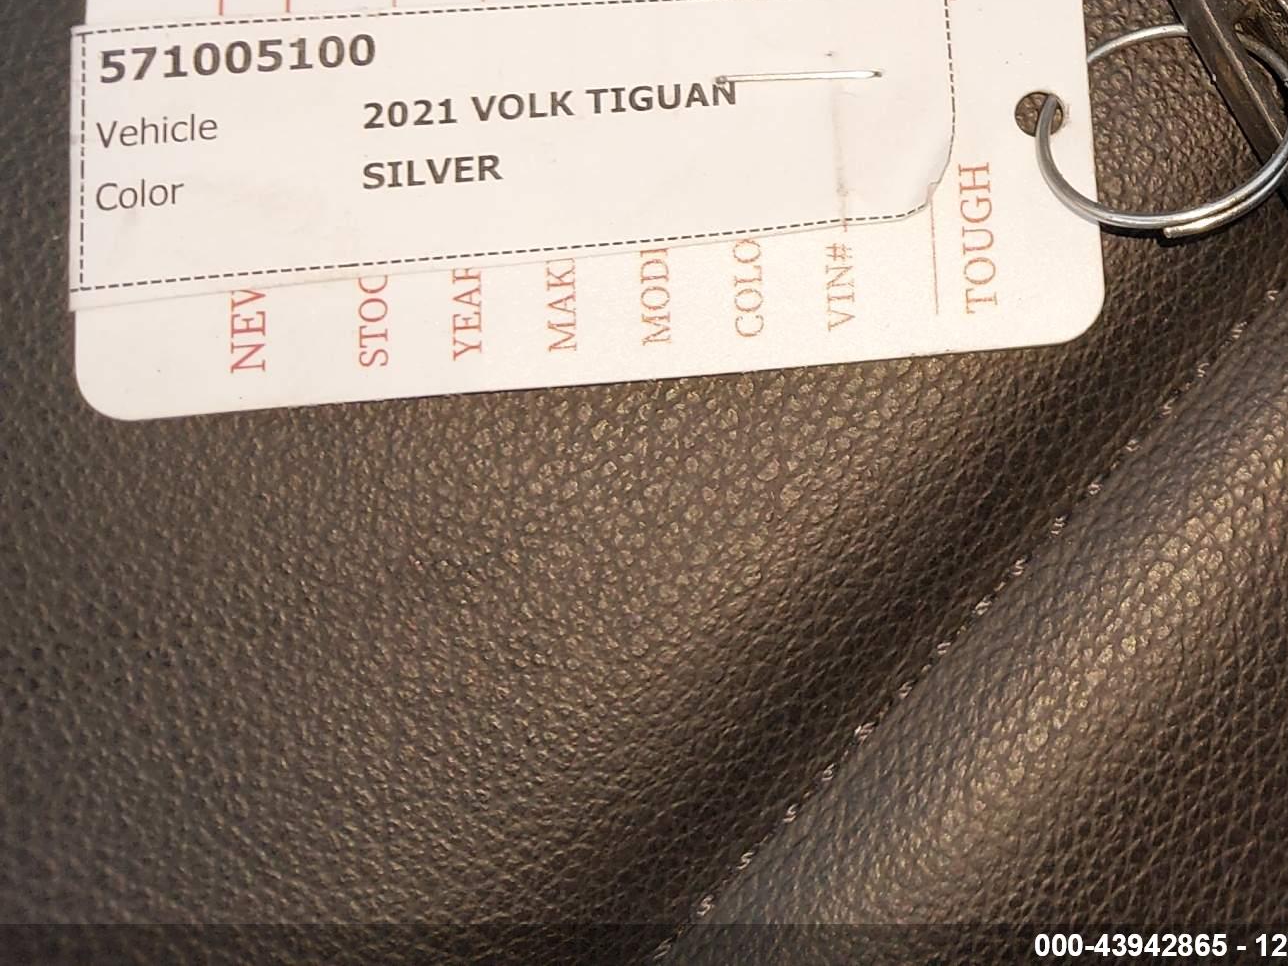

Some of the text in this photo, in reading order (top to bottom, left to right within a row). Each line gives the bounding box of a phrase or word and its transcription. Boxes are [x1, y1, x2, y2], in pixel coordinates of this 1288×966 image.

[99, 33, 377, 84] 571005100
[95, 80, 737, 149] Vehicle 2021 VOLK TIGUAN
[95, 154, 504, 211] Color SILVER
[957, 161, 999, 315] TOUGH
[546, 257, 578, 353] MAK
[639, 246, 672, 347] MOD
[824, 241, 856, 332] VIN#
